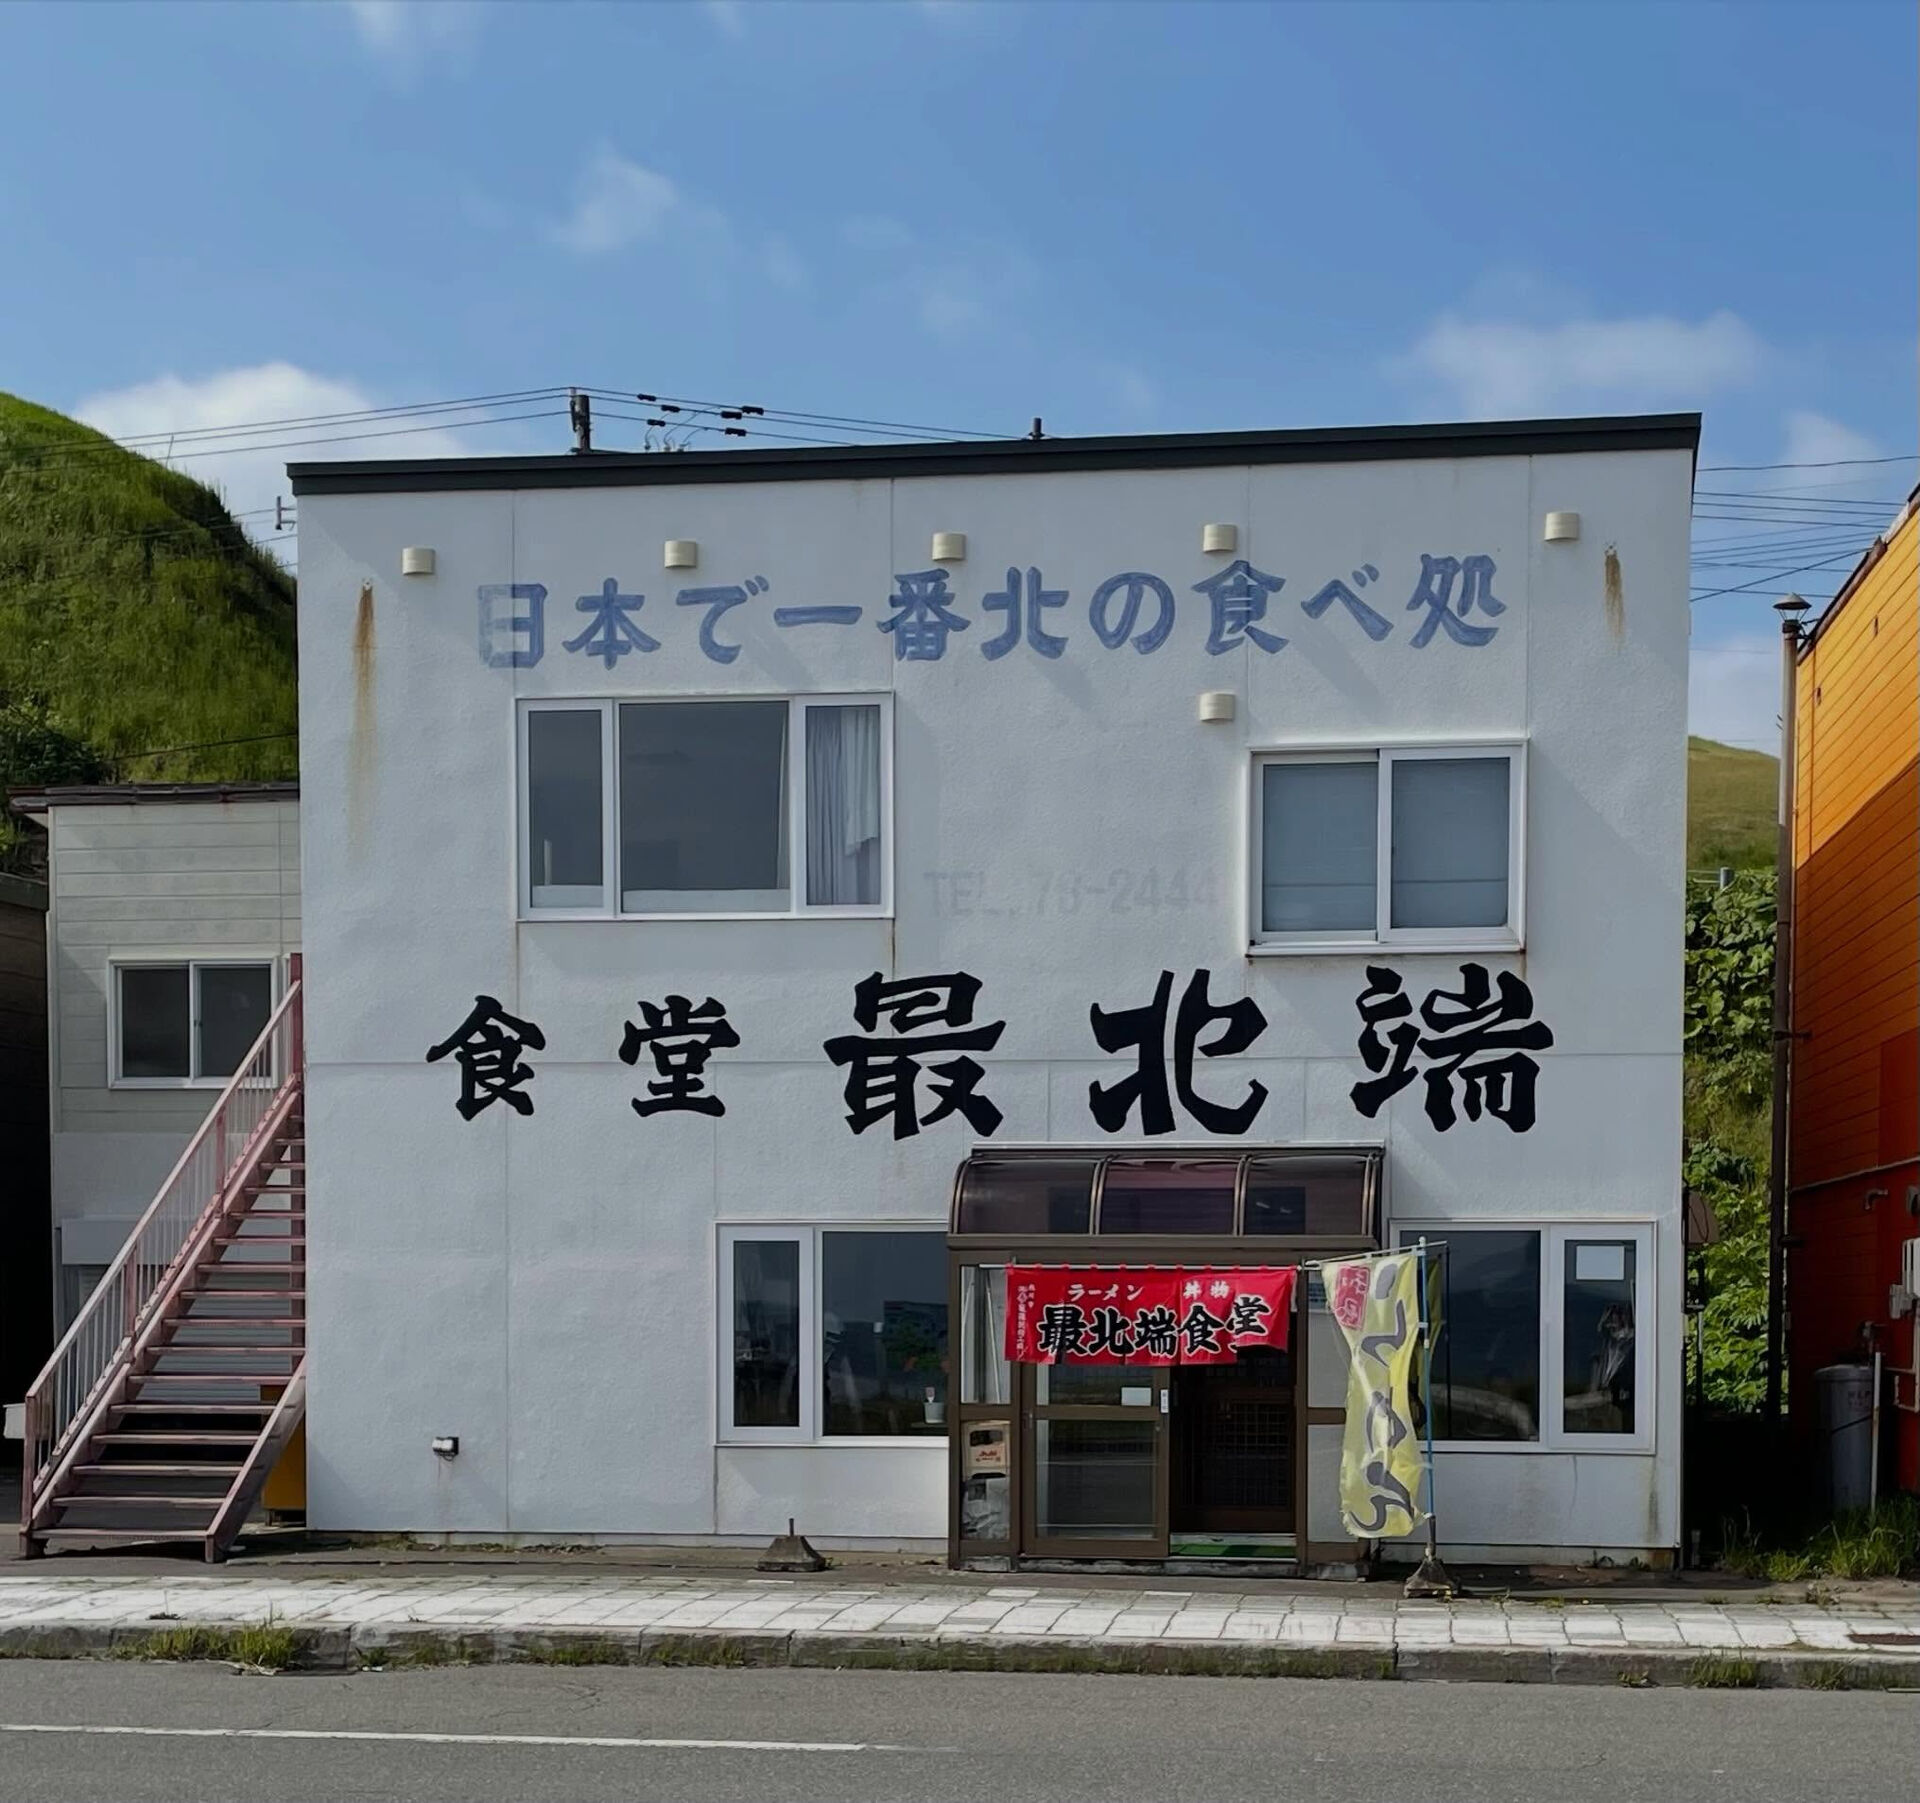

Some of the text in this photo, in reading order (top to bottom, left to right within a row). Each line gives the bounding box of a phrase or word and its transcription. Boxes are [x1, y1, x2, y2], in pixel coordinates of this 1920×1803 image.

[479, 553, 1505, 670] 日本で一番北の食べ処
[1068, 1283, 1145, 1301] ラーメン
[1036, 1293, 1271, 1357] 最北端食堂
